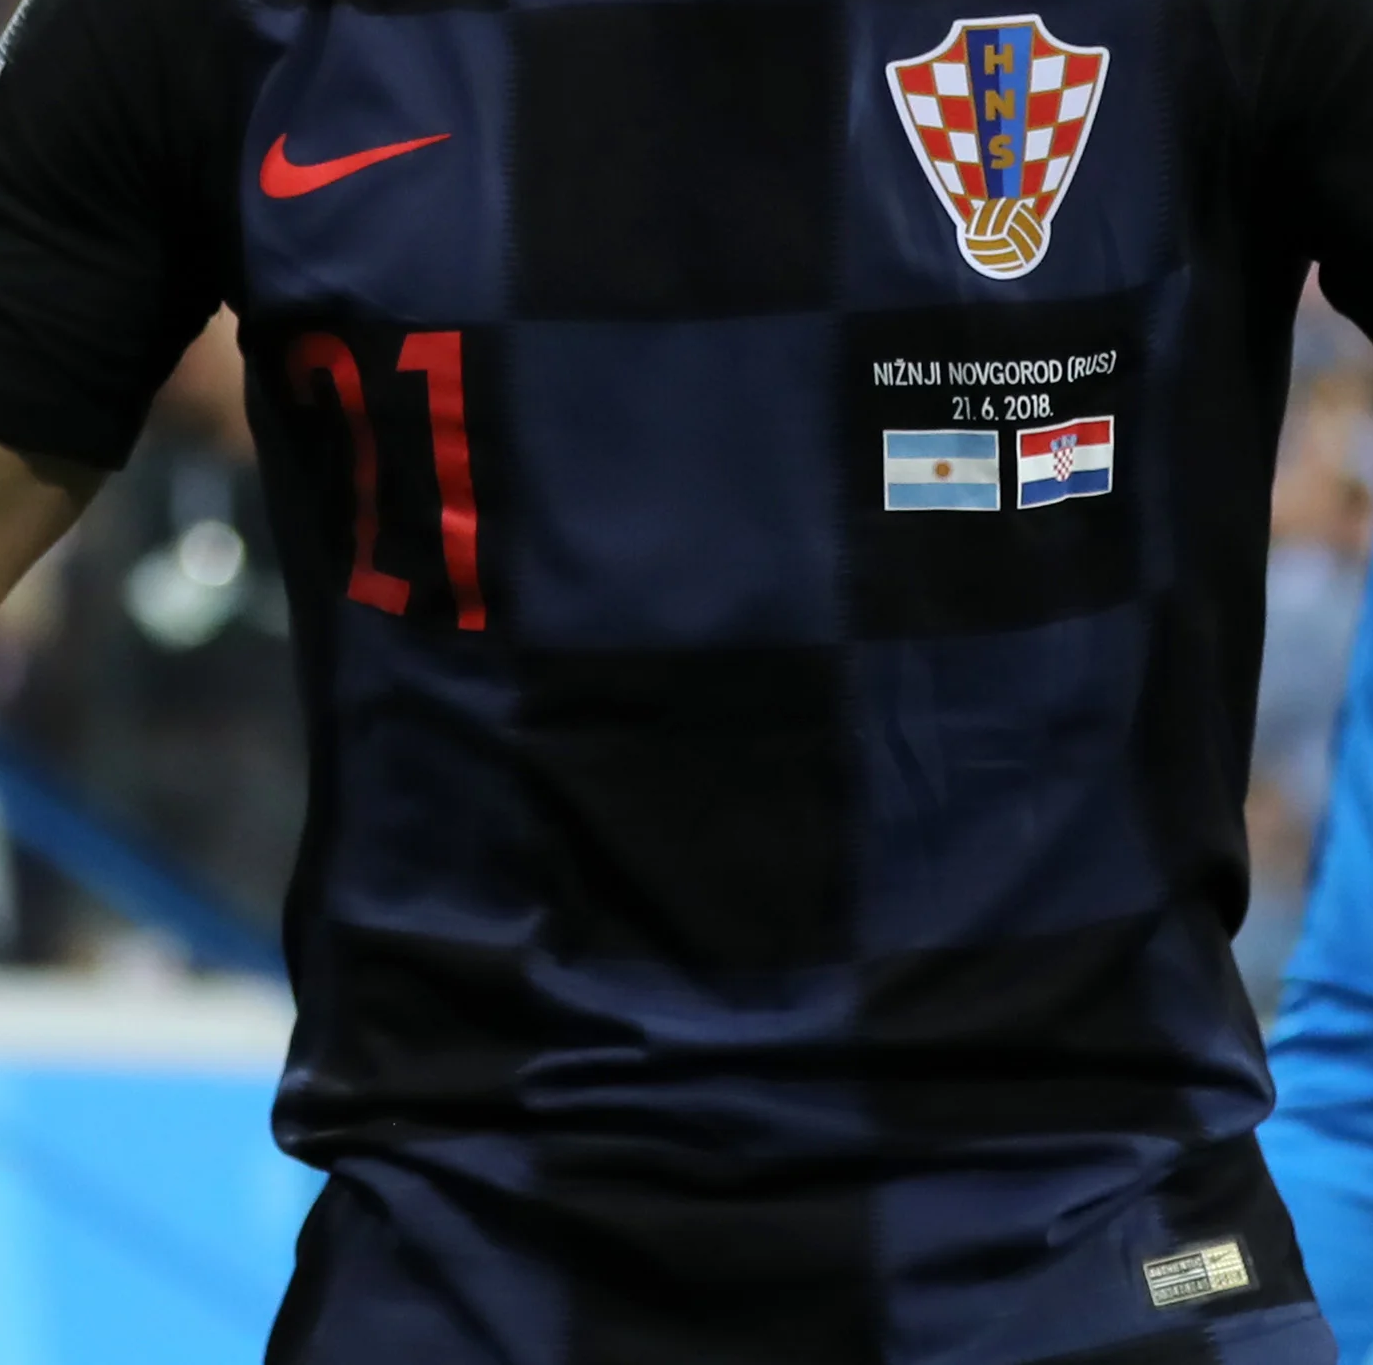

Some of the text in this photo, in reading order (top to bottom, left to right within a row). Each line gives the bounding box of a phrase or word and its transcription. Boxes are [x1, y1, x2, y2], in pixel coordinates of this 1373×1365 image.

[983, 44, 1016, 170] HNS
[873, 350, 1117, 386] NIŽNJI NOVGOROD (RUS)
[951, 394, 1054, 421] 21. 6. 2018.
[286, 330, 487, 632] 21
